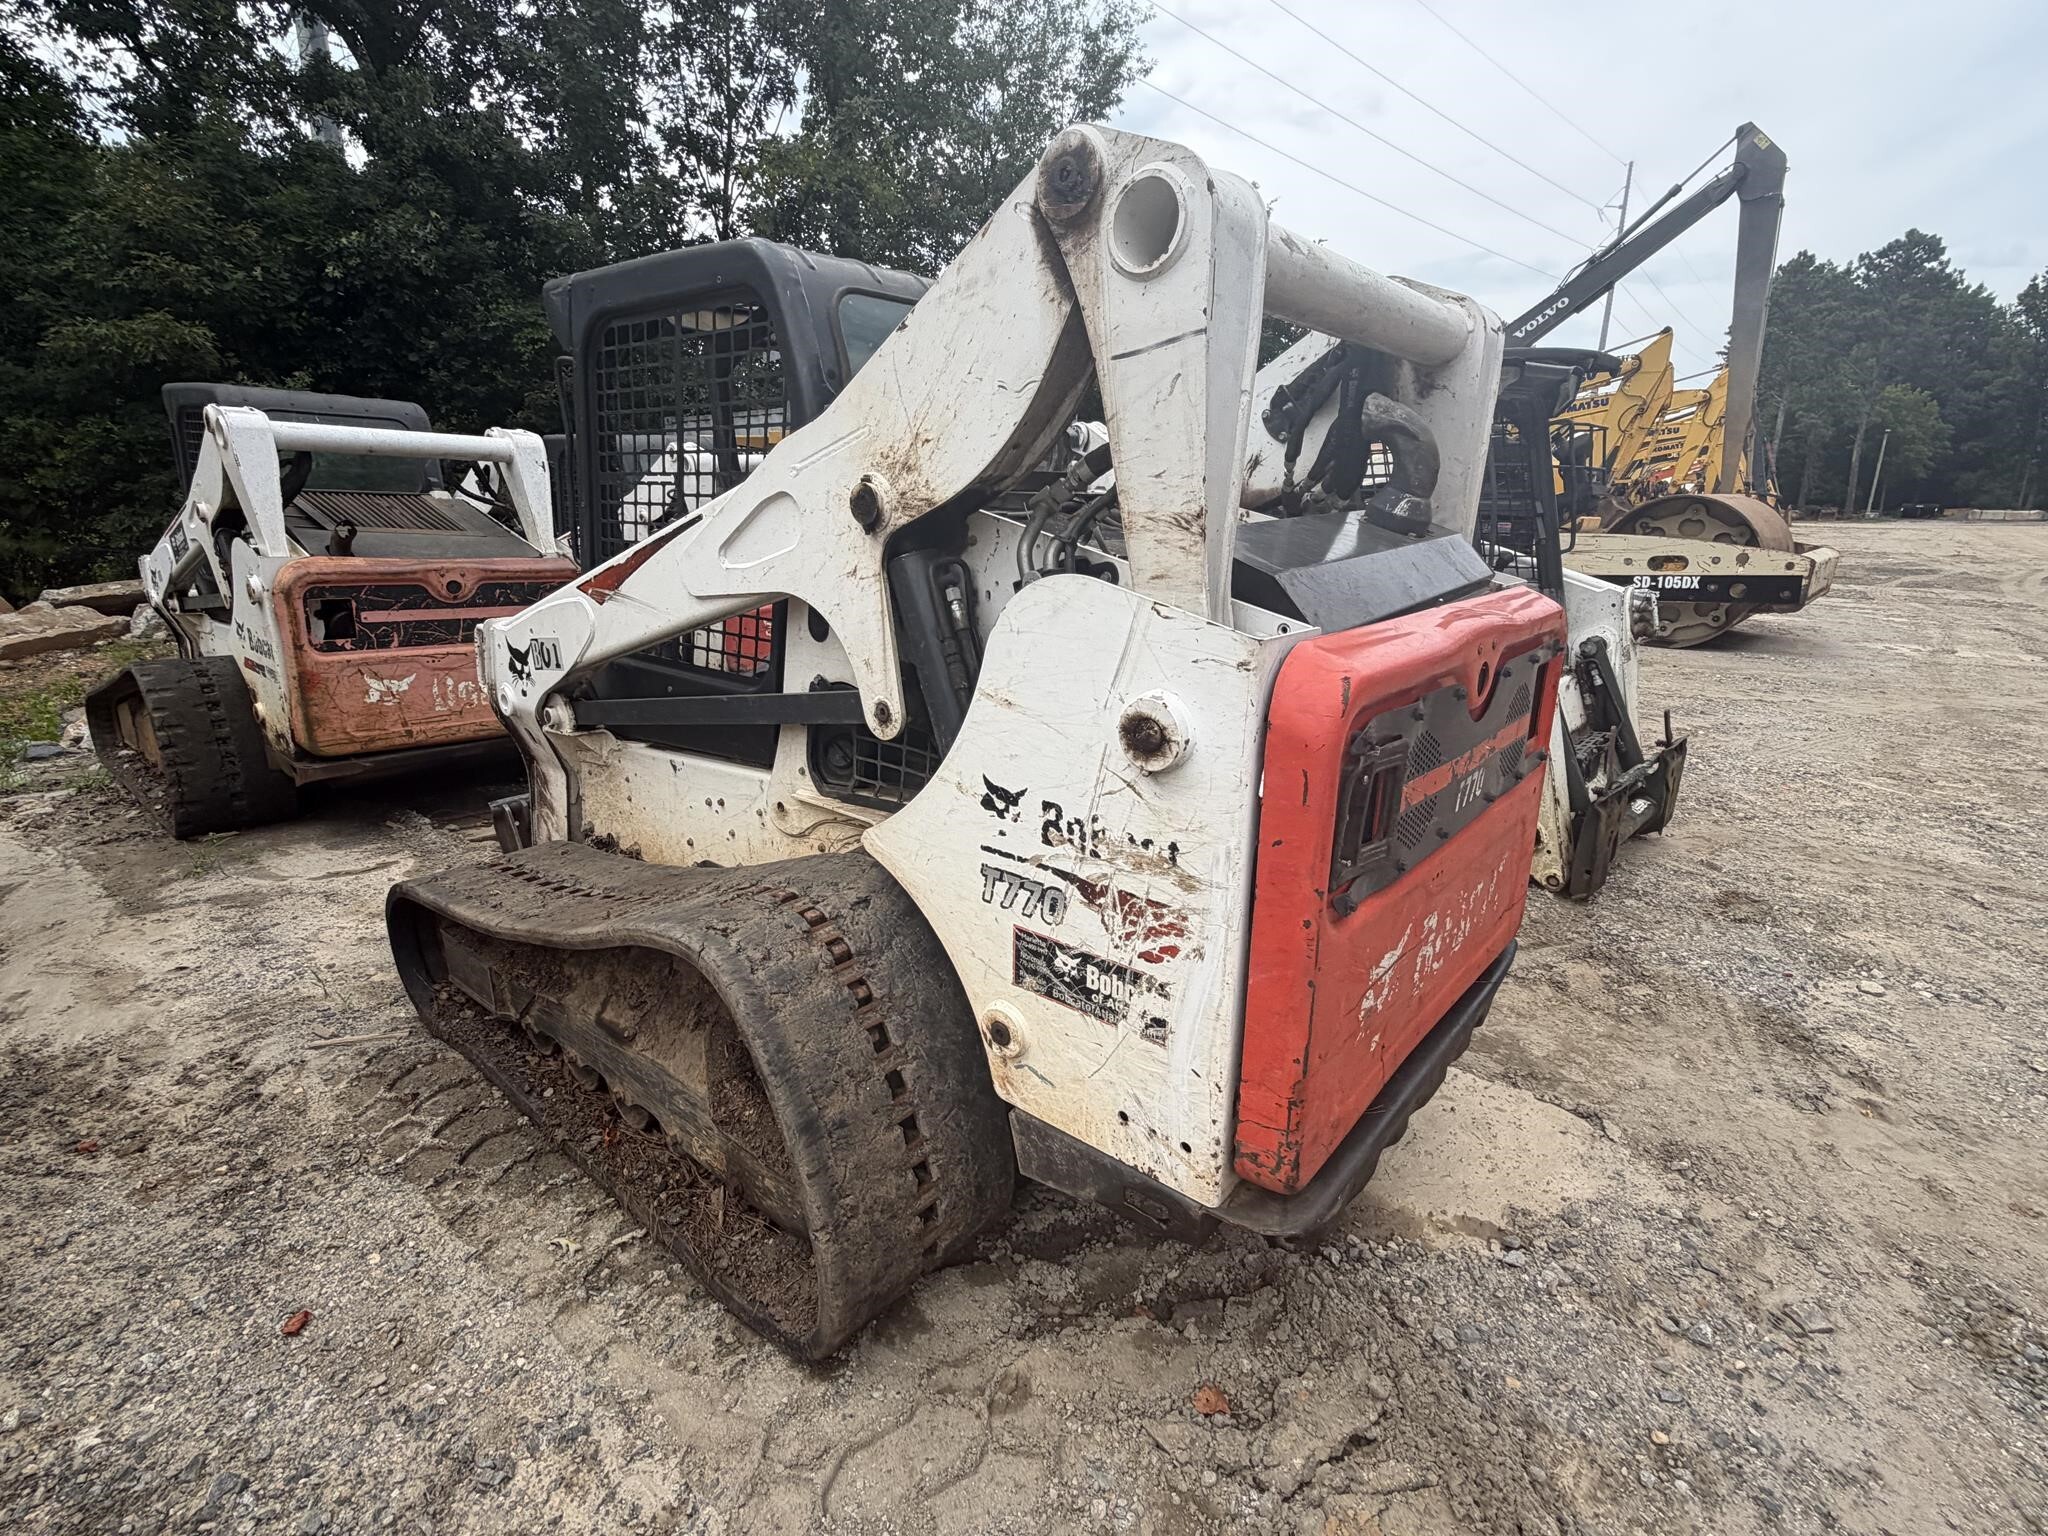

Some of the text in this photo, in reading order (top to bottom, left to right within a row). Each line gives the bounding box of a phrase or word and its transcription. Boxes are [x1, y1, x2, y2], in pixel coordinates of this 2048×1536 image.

[1513, 297, 1569, 338] VOLVO
[1633, 575, 1701, 589] SD-105DX
[980, 862, 1068, 925] T770
